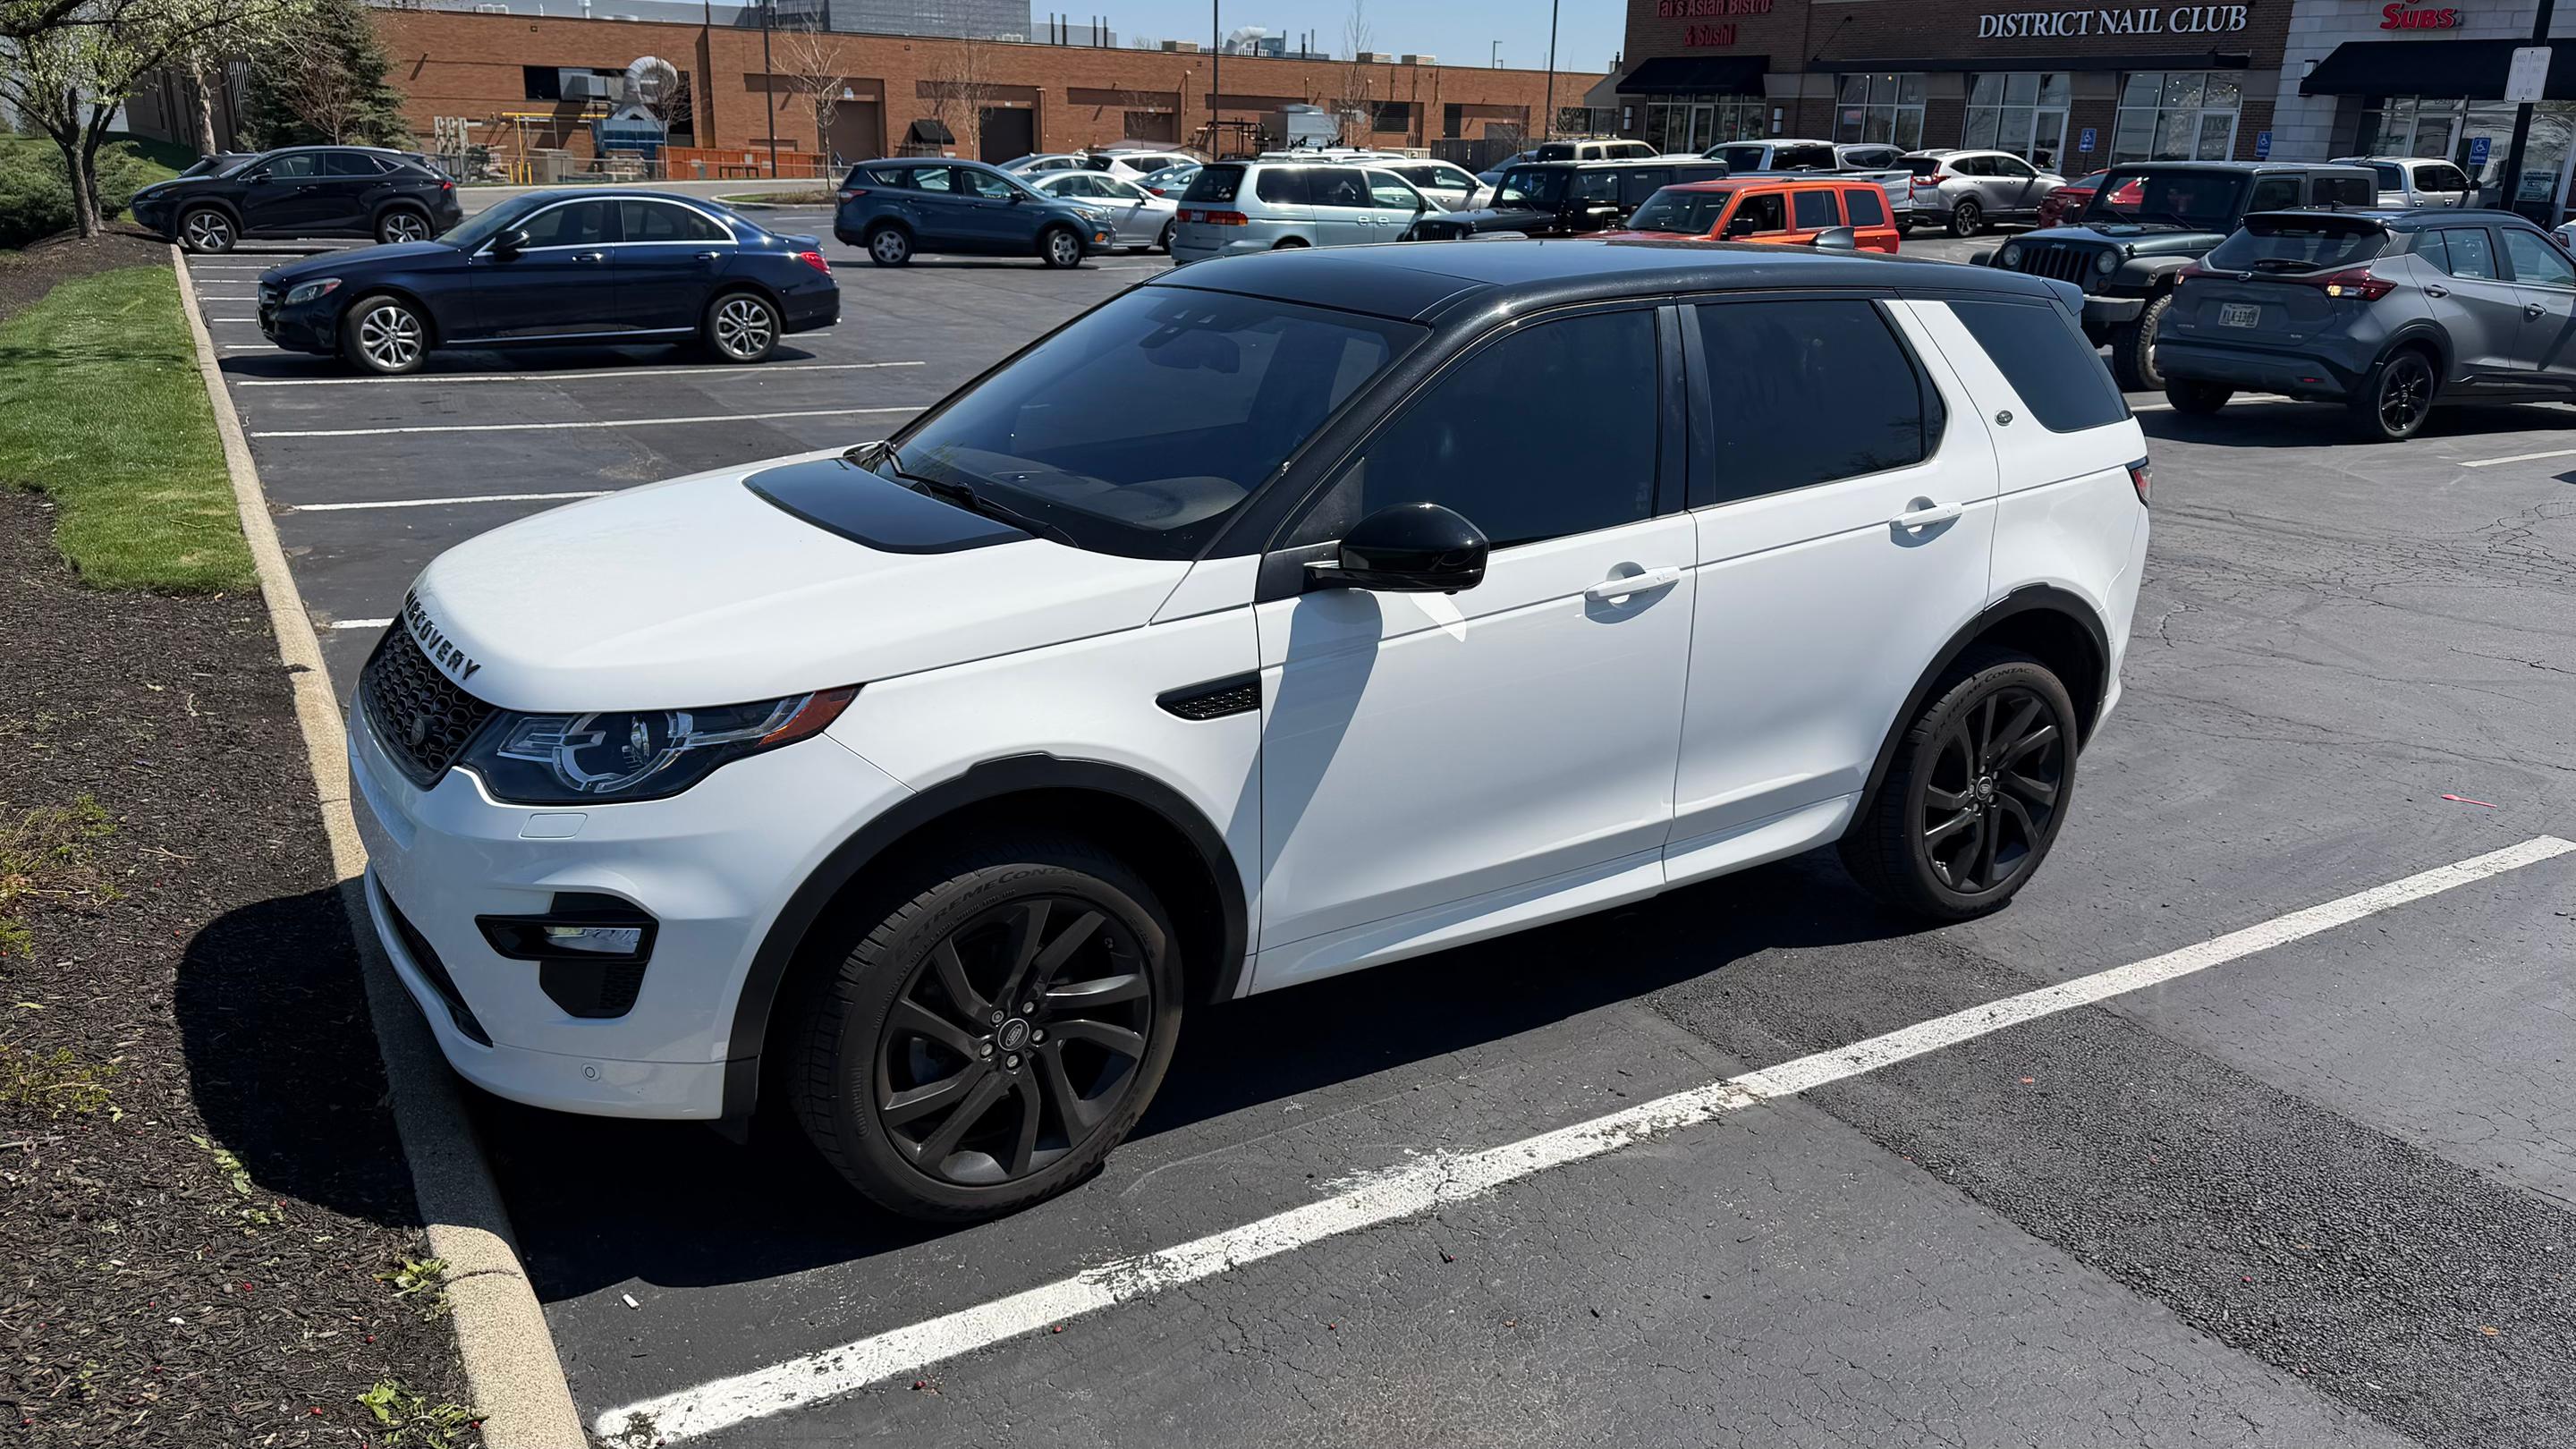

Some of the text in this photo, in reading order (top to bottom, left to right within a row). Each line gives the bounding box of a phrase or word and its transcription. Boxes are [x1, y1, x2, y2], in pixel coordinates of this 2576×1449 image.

[1686, 0, 1724, 16] Asian
[1728, 0, 1770, 15] Bistro
[1977, 5, 2248, 38] DISTRICT NAIL CLUB
[1682, 25, 1733, 46] & Sushi
